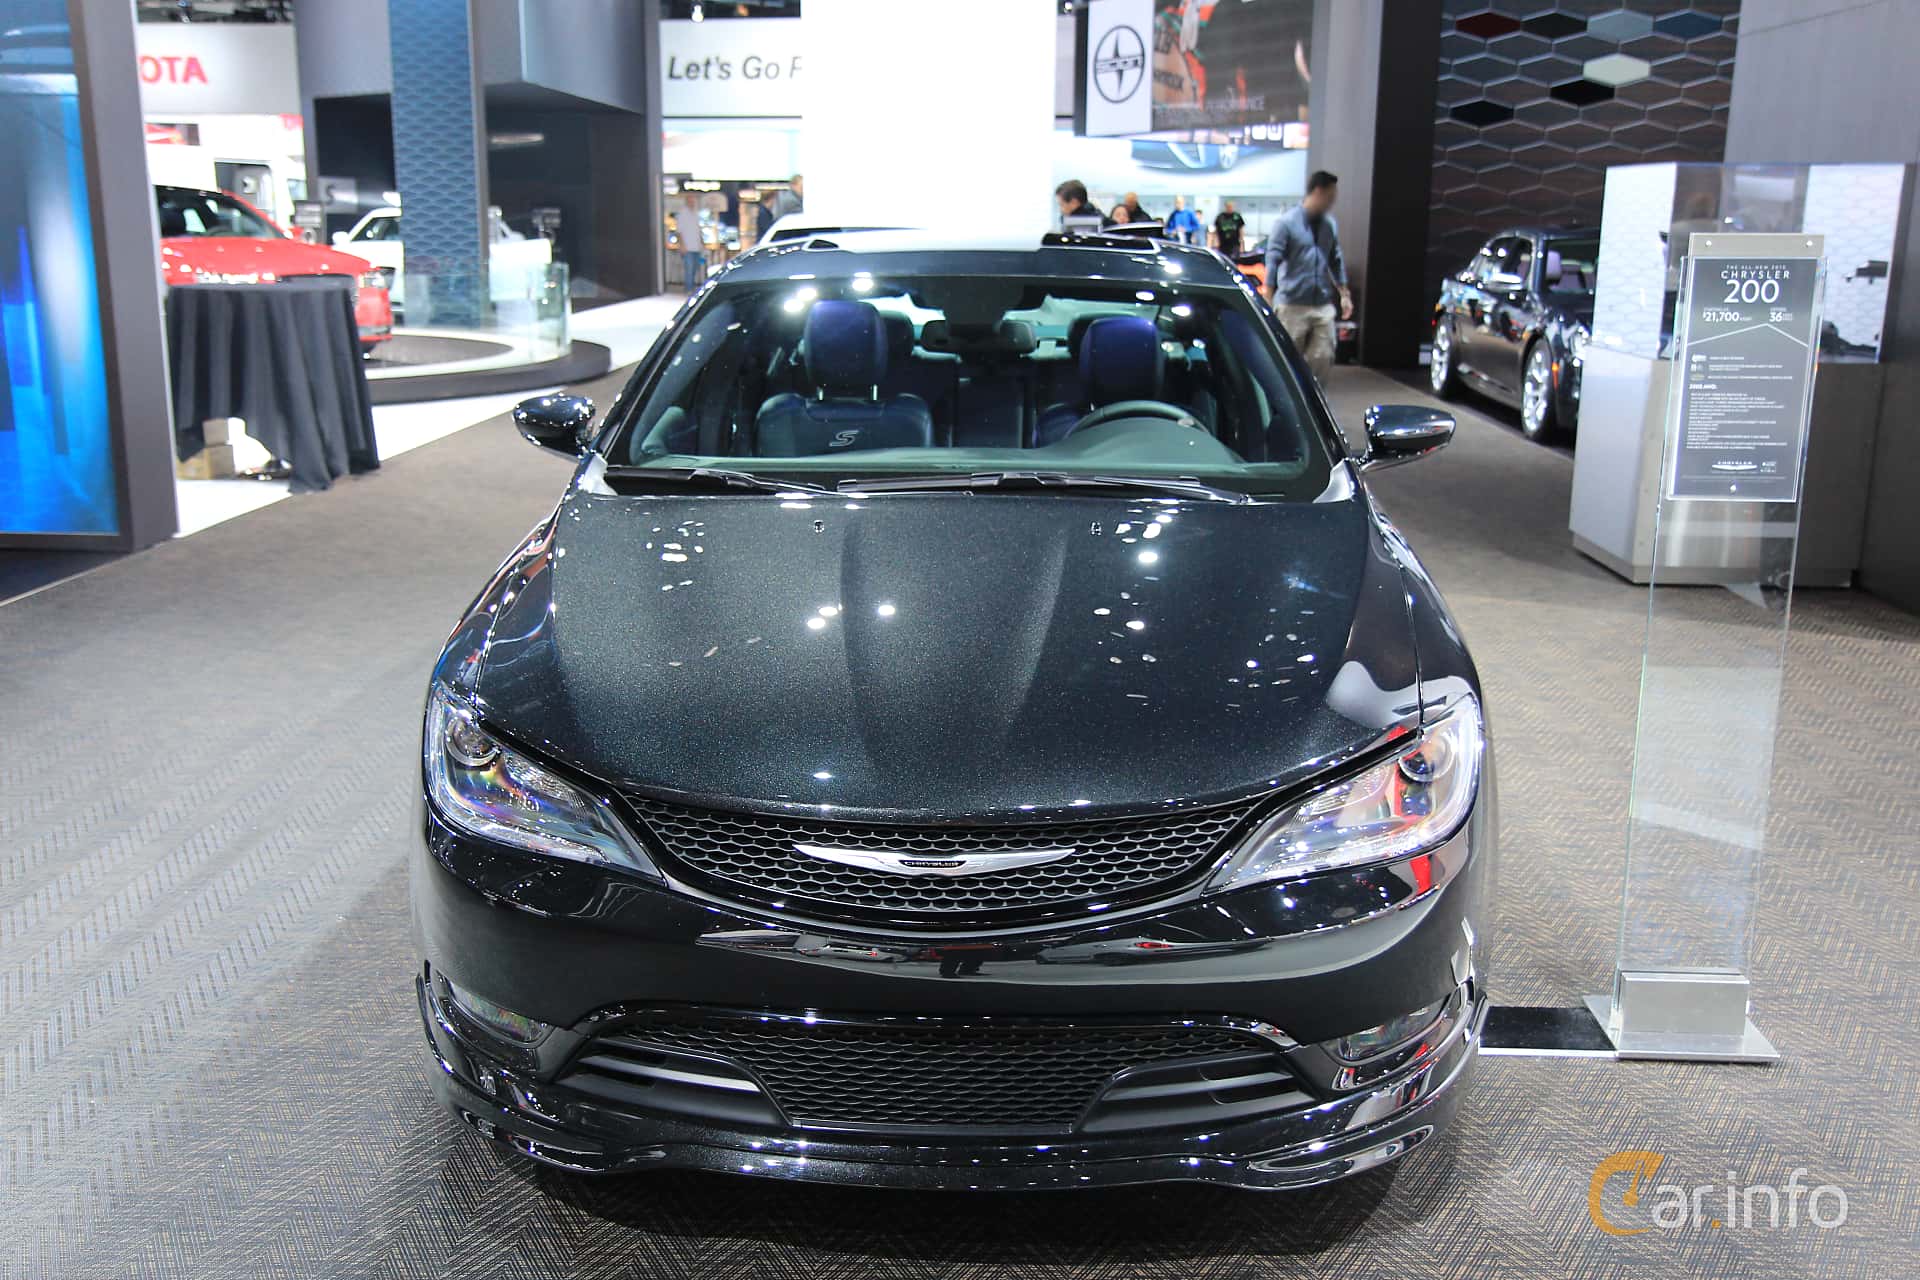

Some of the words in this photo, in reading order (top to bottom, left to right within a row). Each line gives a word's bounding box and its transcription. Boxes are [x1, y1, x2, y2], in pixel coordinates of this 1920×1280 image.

[668, 56, 731, 80] Let's
[742, 56, 780, 80] Go
[1720, 270, 1790, 280] CHRYSLER
[1723, 279, 1780, 304] 200
[1769, 311, 1783, 323] 36
[828, 429, 859, 447] S
